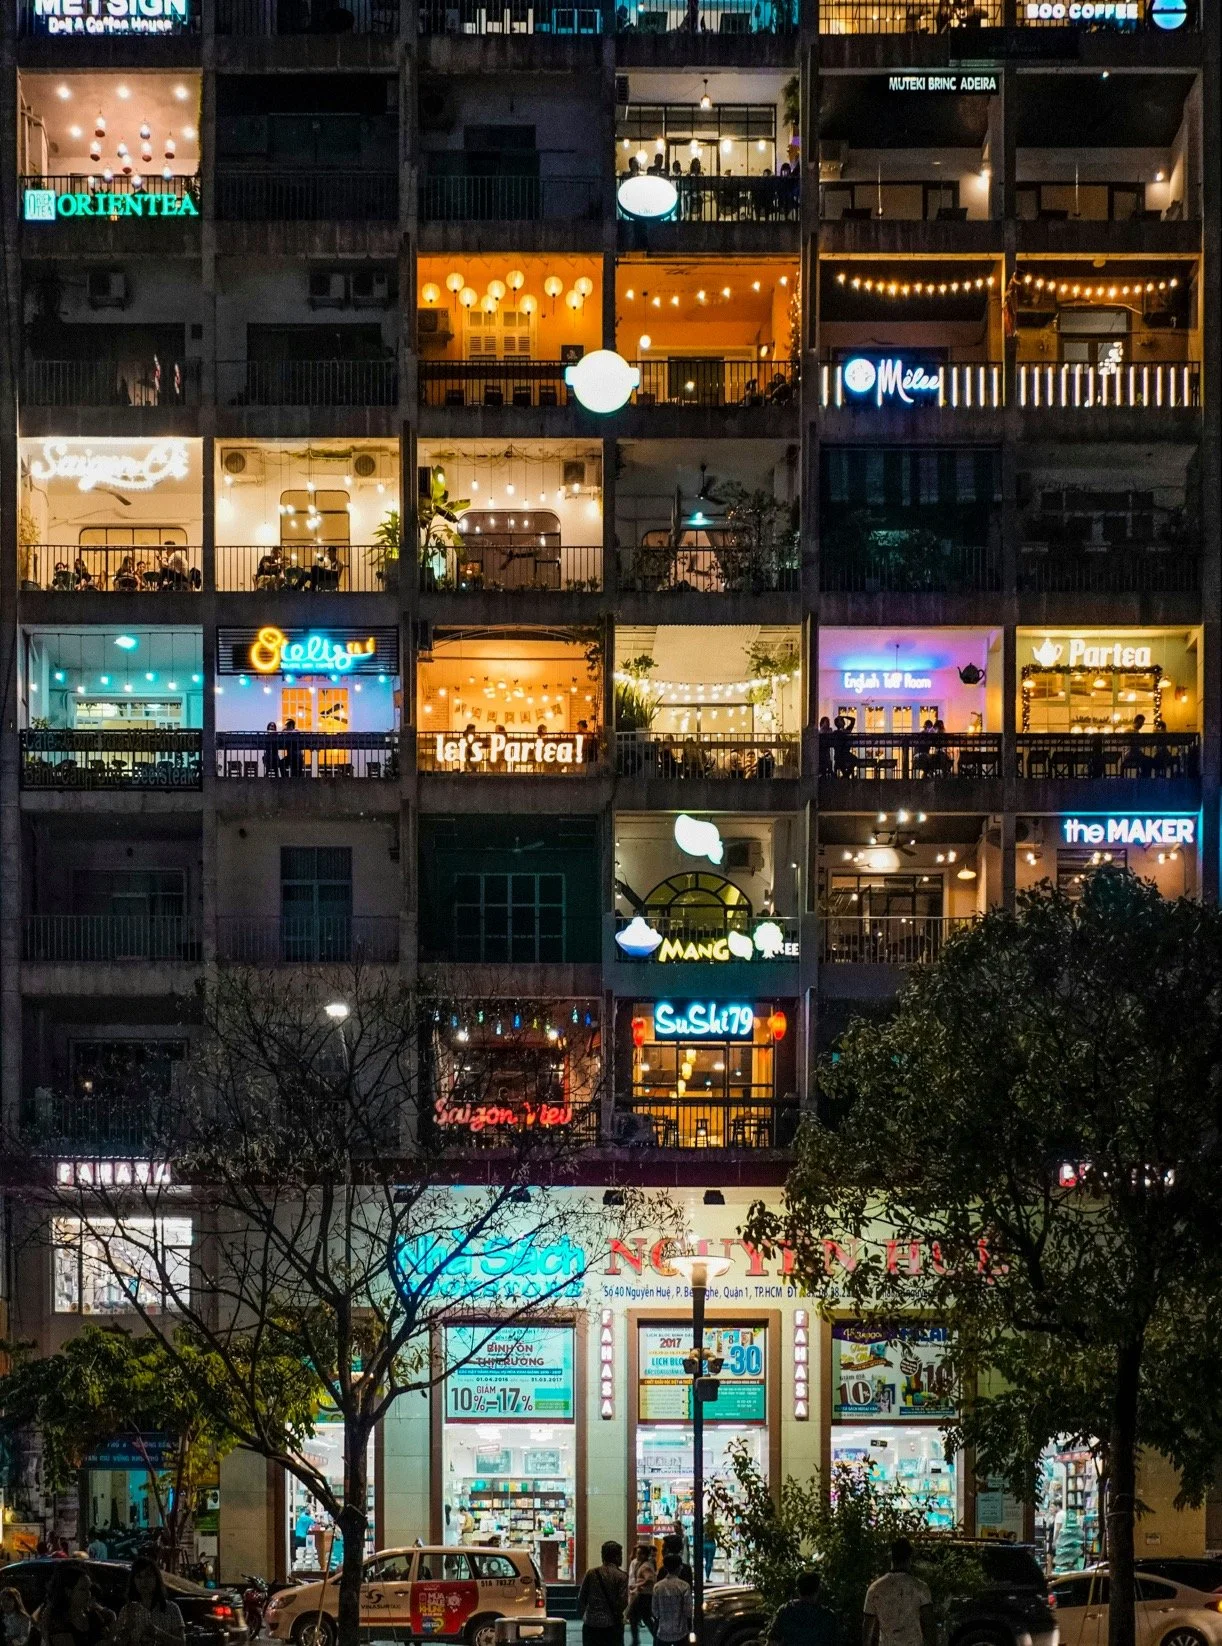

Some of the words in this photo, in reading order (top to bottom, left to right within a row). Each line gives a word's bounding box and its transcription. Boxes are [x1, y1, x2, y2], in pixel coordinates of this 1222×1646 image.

[1069, 4, 1138, 19] COFFEE
[131, 16, 172, 33] House
[889, 77, 926, 91] MUTEKI
[928, 77, 957, 90] BRINC
[960, 77, 996, 90] ADEIRA
[57, 193, 199, 216] ORIENTEA
[1069, 639, 1151, 667] Partea
[844, 672, 879, 693] English
[904, 672, 932, 688] Room
[490, 734, 584, 763] Partea!
[1064, 819, 1105, 843] the
[1107, 819, 1194, 843] MAKER
[433, 1097, 518, 1132] Saigon
[480, 1231, 585, 1276] Sách
[615, 1286, 625, 1297] 40
[755, 1286, 782, 1298] TP.HCM
[660, 1338, 682, 1348] 2017
[601, 1310, 613, 1416] FAHASA
[794, 1310, 807, 1416] FAHASA
